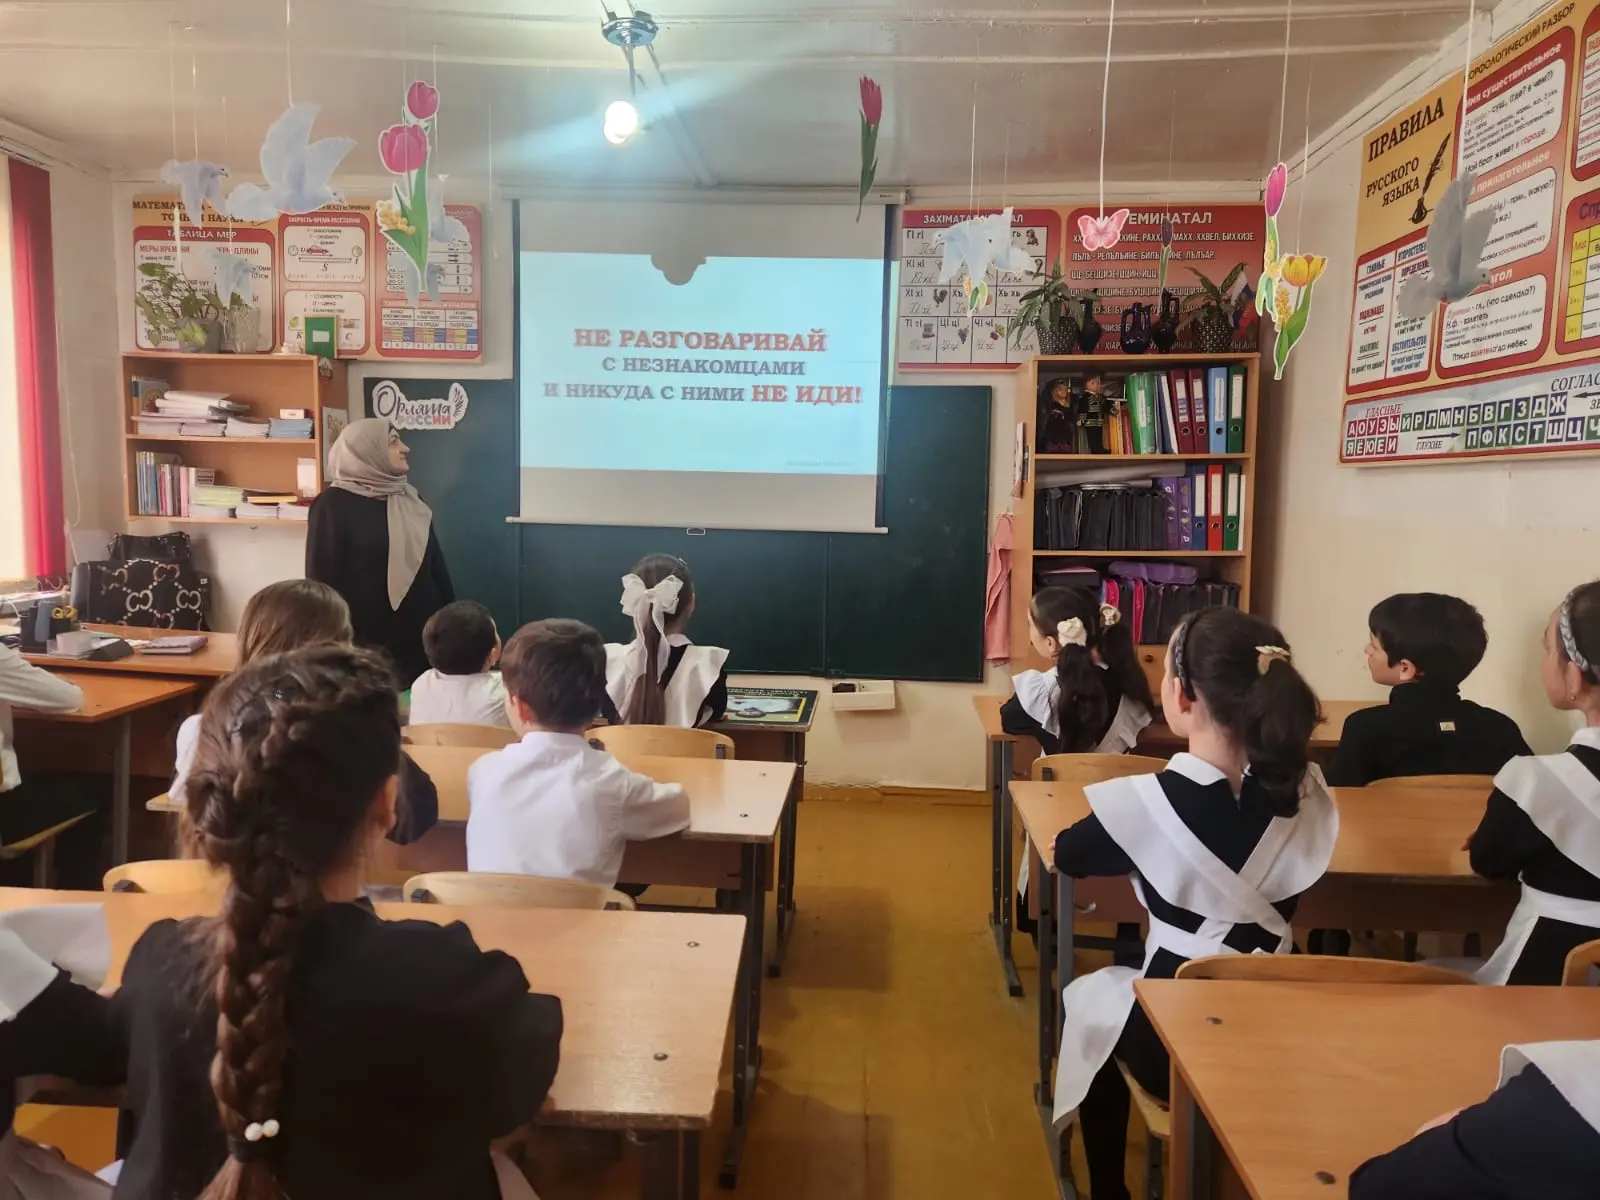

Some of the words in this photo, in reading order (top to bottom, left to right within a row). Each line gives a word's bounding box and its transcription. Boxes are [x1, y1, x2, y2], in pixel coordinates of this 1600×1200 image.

[1464, 25, 1541, 83] ОРФОЛОГИЧЕСКИЙ
[1541, 2, 1575, 32] РАЗБОР
[1368, 97, 1444, 162] ПРАВИЛА
[1366, 157, 1419, 198] РУССКОГО
[1382, 176, 1420, 207] ЯЗЫКА
[217, 231, 237, 239] МЕР
[574, 328, 611, 347] НЕ
[618, 328, 827, 352] РАЗГОВАРИВАЙ
[1507, 339, 1528, 350] небес
[602, 357, 616, 371] С
[622, 357, 806, 377] НЕЗНАКОМЦАМИ
[543, 383, 560, 398] И
[565, 383, 654, 401] НИКУДА
[660, 386, 674, 400] С
[680, 386, 745, 402] НИМИ
[751, 384, 788, 403] НЕ
[795, 384, 862, 406] ИДИ!
[398, 415, 451, 425] РОССИИ
[1366, 402, 1403, 418] ГЛАСНЫЕ
[1416, 440, 1444, 451] ГЛУХИЕ
